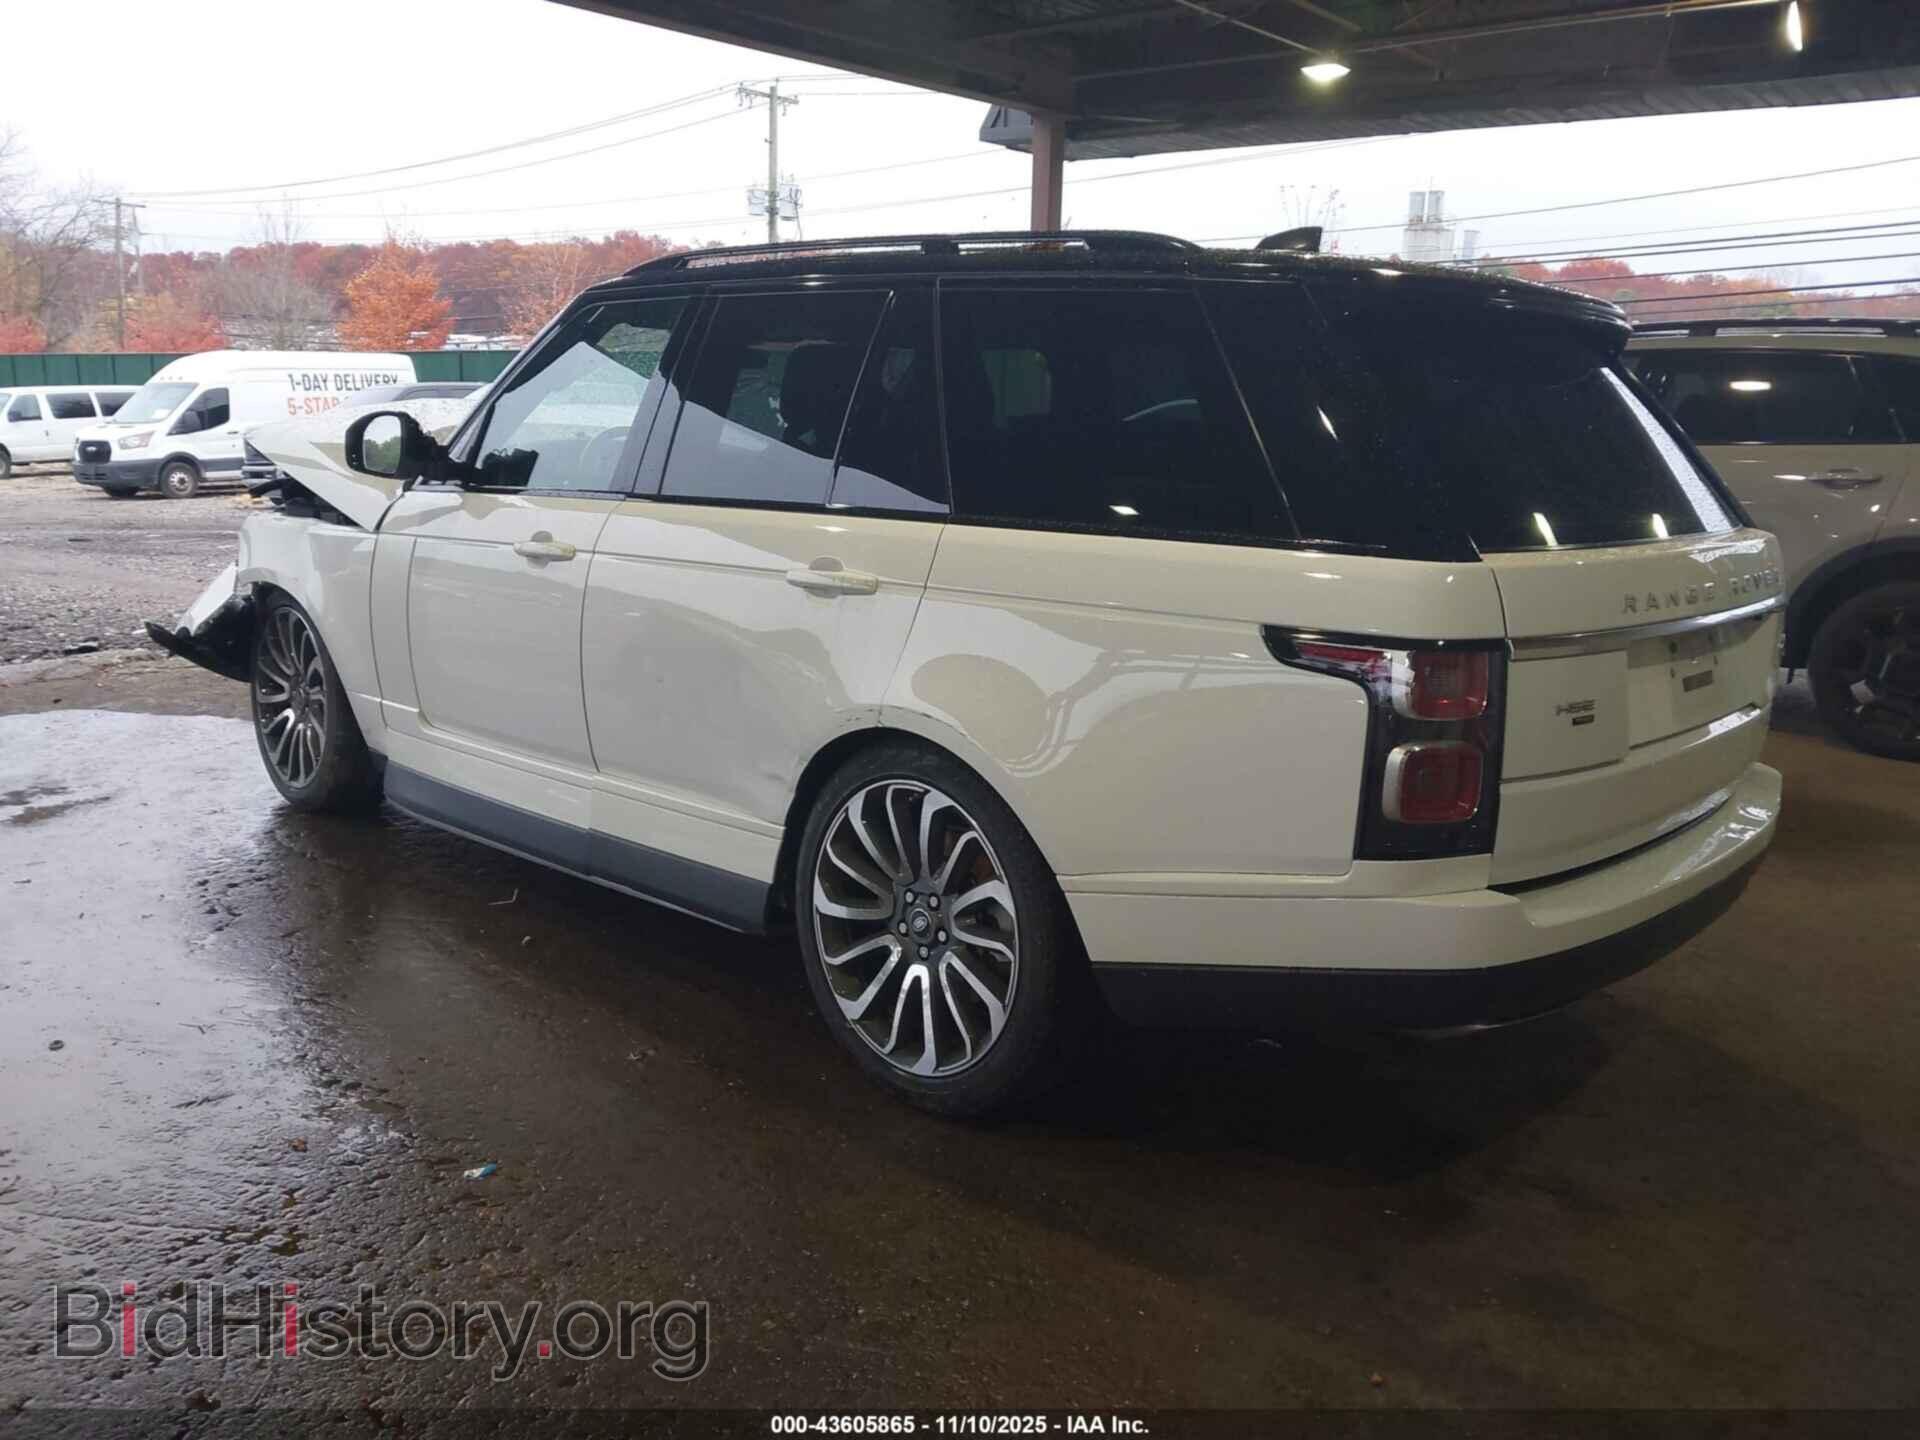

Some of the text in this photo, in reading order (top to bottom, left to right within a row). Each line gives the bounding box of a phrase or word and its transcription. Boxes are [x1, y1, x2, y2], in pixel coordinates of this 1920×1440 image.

[288, 373, 398, 391] 1-DAY DELIVERY
[1622, 581, 1716, 613] RANGE
